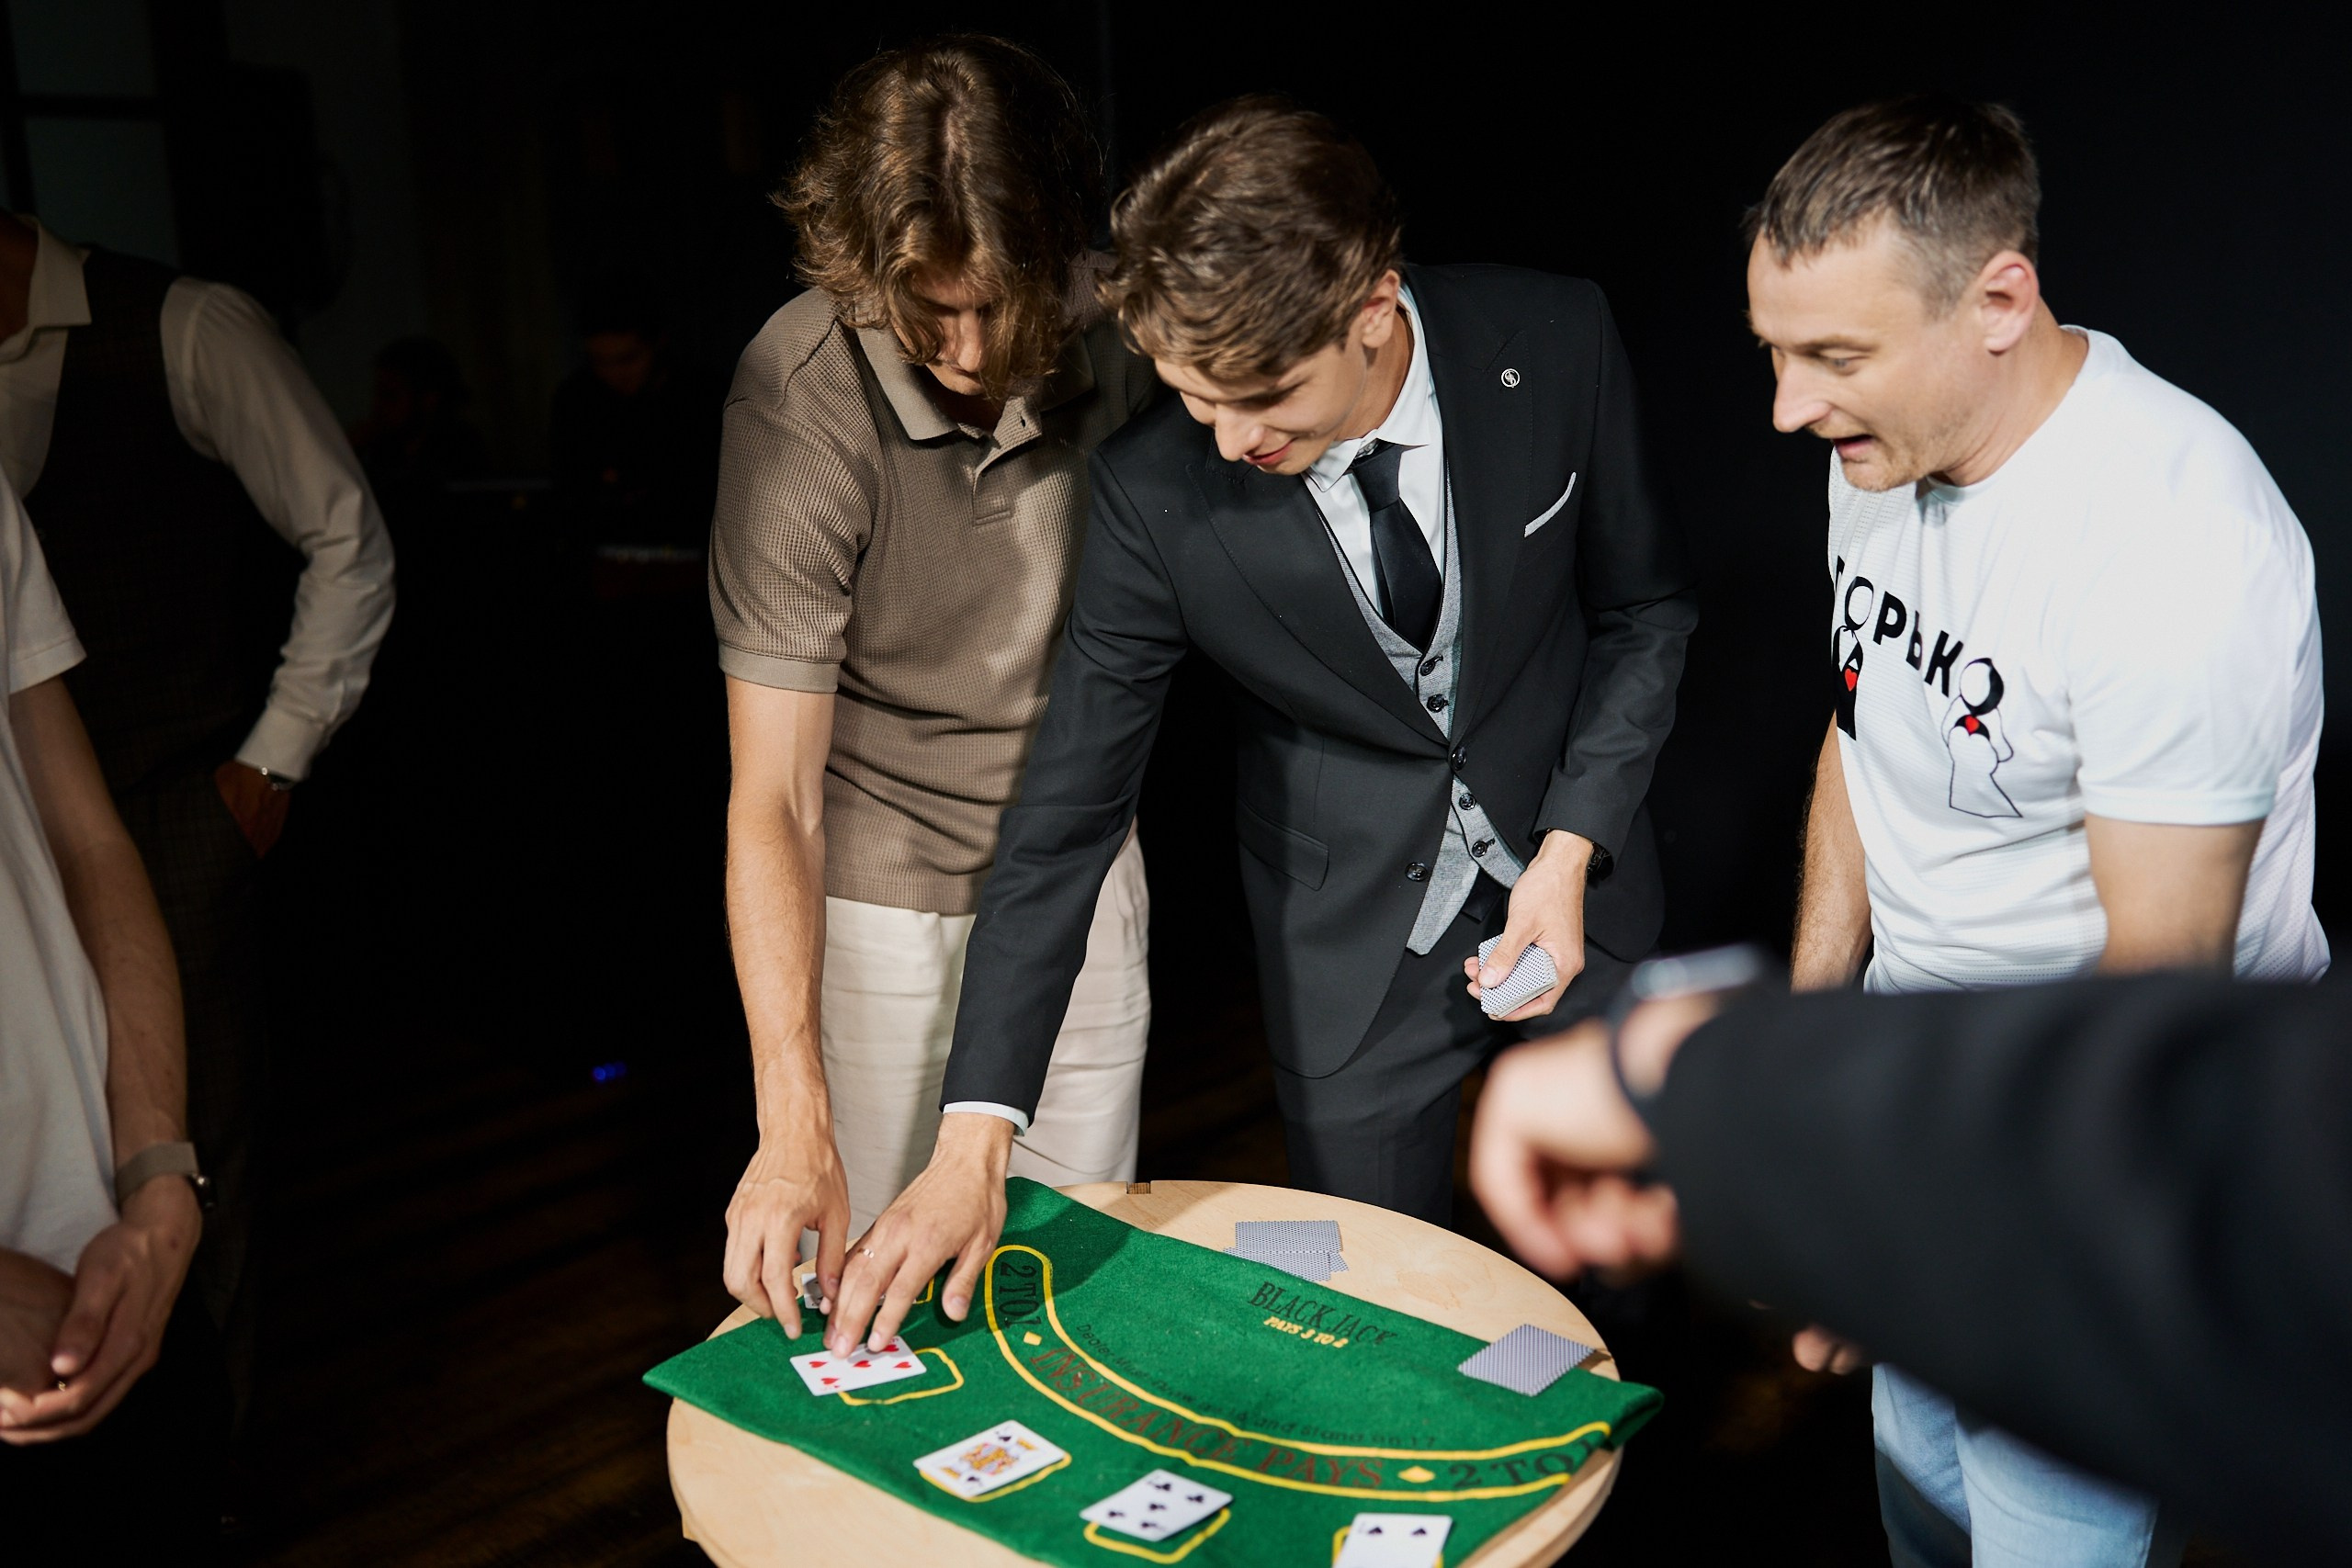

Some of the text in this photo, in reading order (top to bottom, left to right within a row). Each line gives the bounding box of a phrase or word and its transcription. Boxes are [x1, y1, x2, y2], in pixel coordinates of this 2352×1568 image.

[1000, 1261, 1037, 1279] 2
[998, 1282, 1040, 1317] TO
[1247, 1280, 1397, 1346] BLACK JACK
[1262, 1315, 1304, 1336] PAYS
[1300, 1328, 1317, 1340] 3
[1313, 1332, 1336, 1346] TO
[1029, 1346, 1251, 1463] INSURANCE
[1258, 1447, 1384, 1490] PAYS
[1448, 1462, 1483, 1489] 2
[1489, 1452, 1575, 1487] TO
